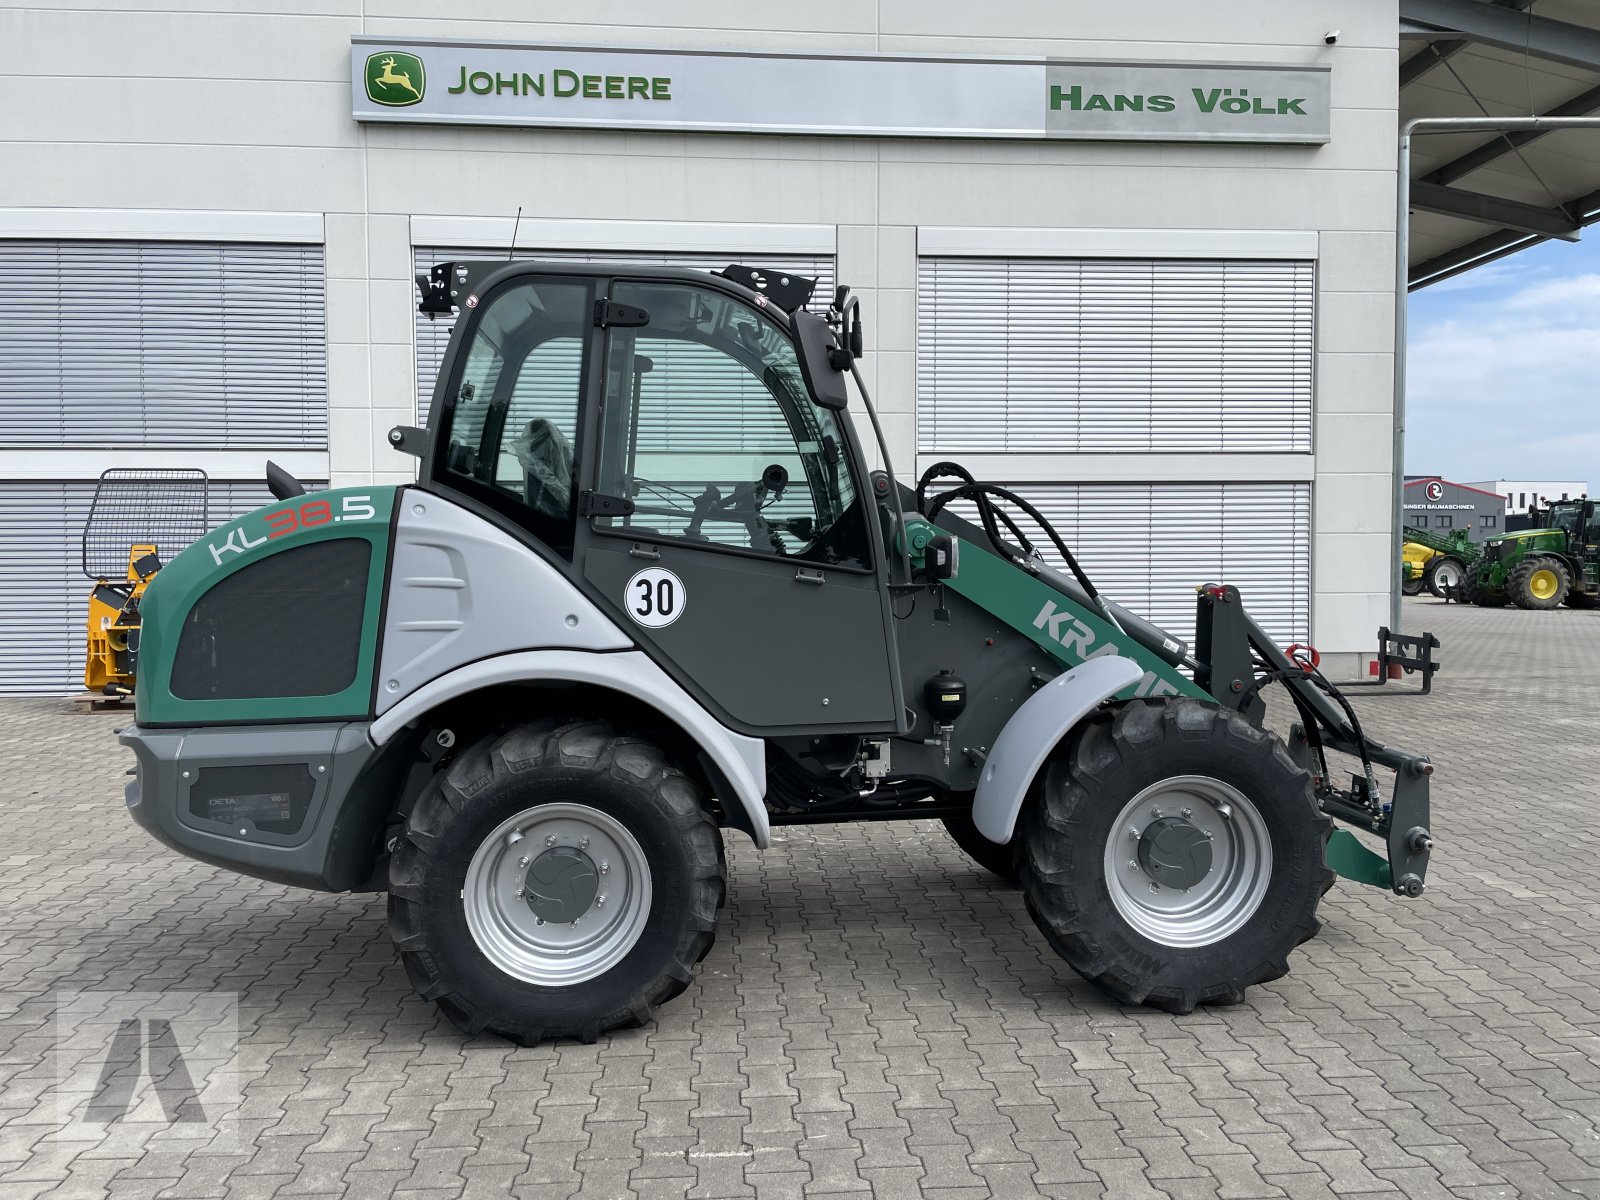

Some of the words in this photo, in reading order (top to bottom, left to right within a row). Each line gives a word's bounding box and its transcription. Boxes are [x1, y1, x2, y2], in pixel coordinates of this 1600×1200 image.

[448, 66, 544, 97] JOHN
[554, 69, 672, 100] DEERE
[1050, 85, 1176, 113] HANS
[1191, 88, 1309, 115] VÖLK
[636, 578, 674, 616] 30
[1032, 599, 1187, 697] KRA
[209, 798, 237, 806] DETA
